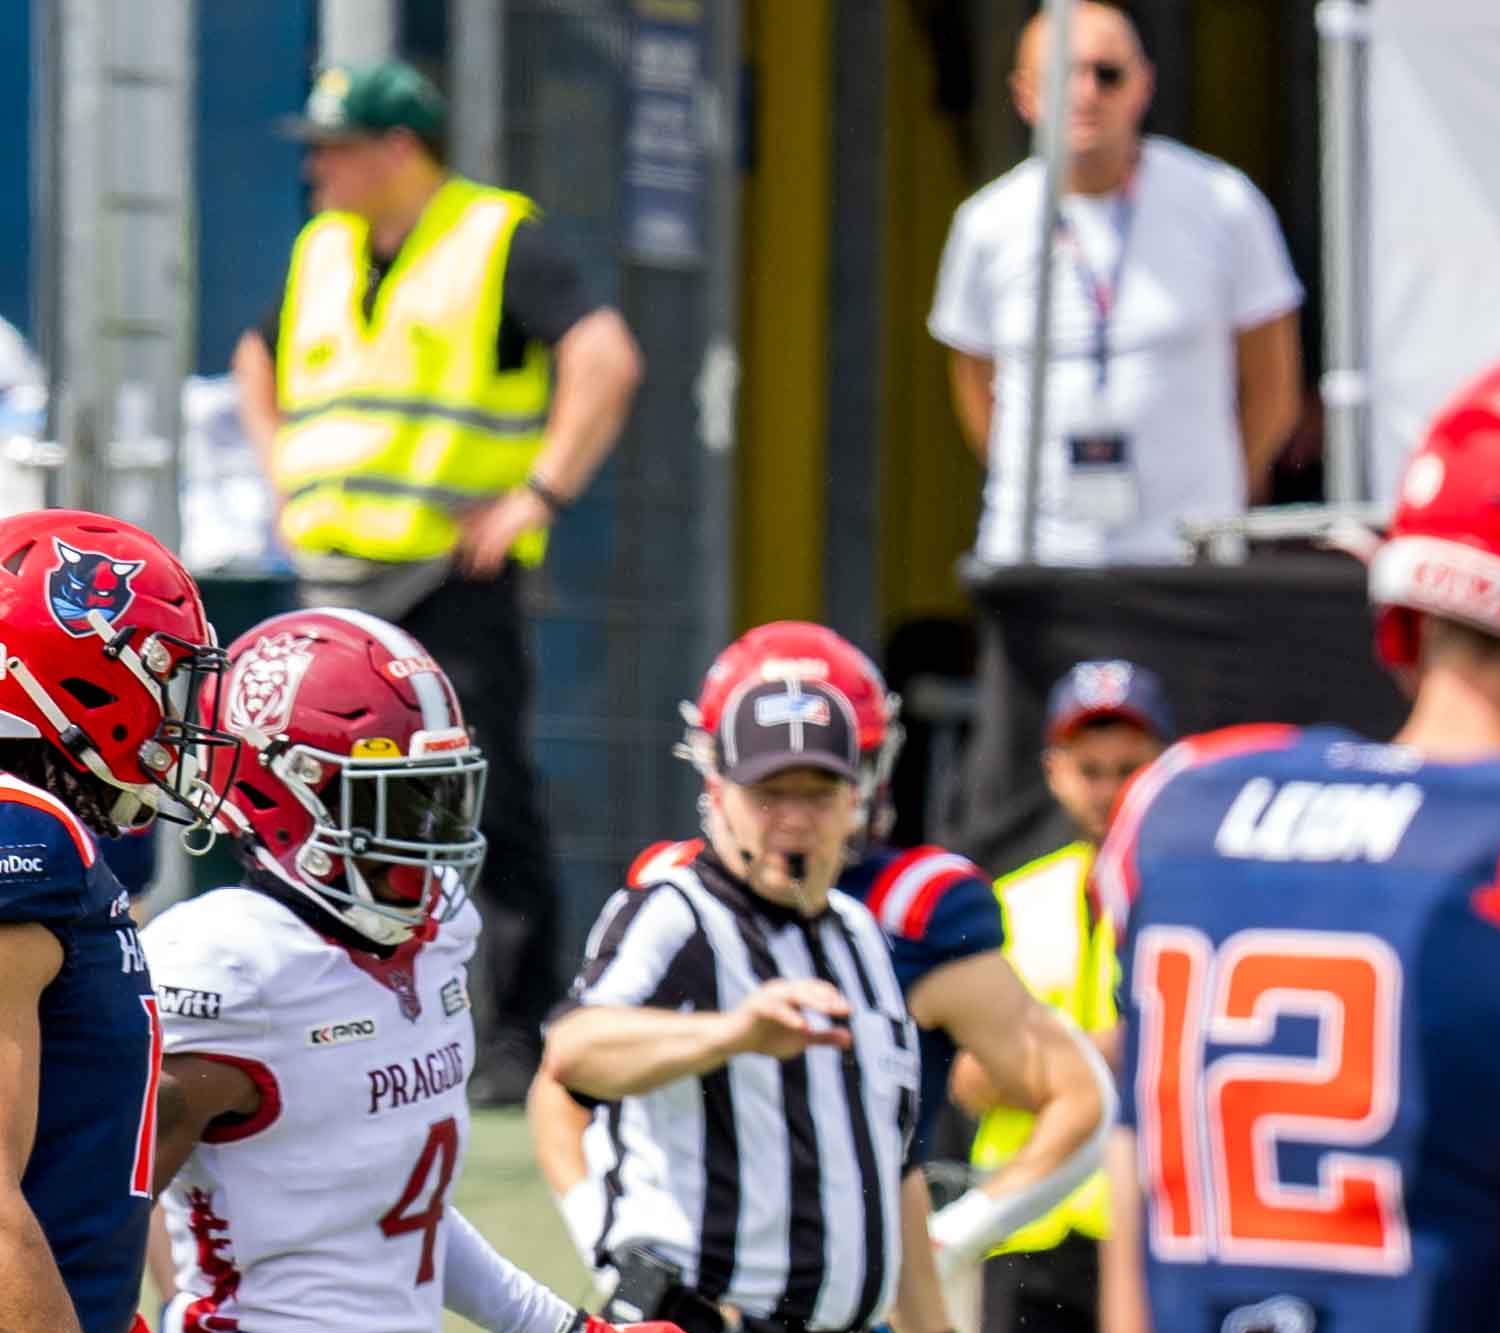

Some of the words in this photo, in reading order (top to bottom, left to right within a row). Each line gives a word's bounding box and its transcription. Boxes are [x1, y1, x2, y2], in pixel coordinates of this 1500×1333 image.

[0, 855, 44, 874] nDoc
[158, 985, 221, 1019] Witt
[1131, 926, 1412, 1275] 12
[379, 1116, 458, 1286] 4
